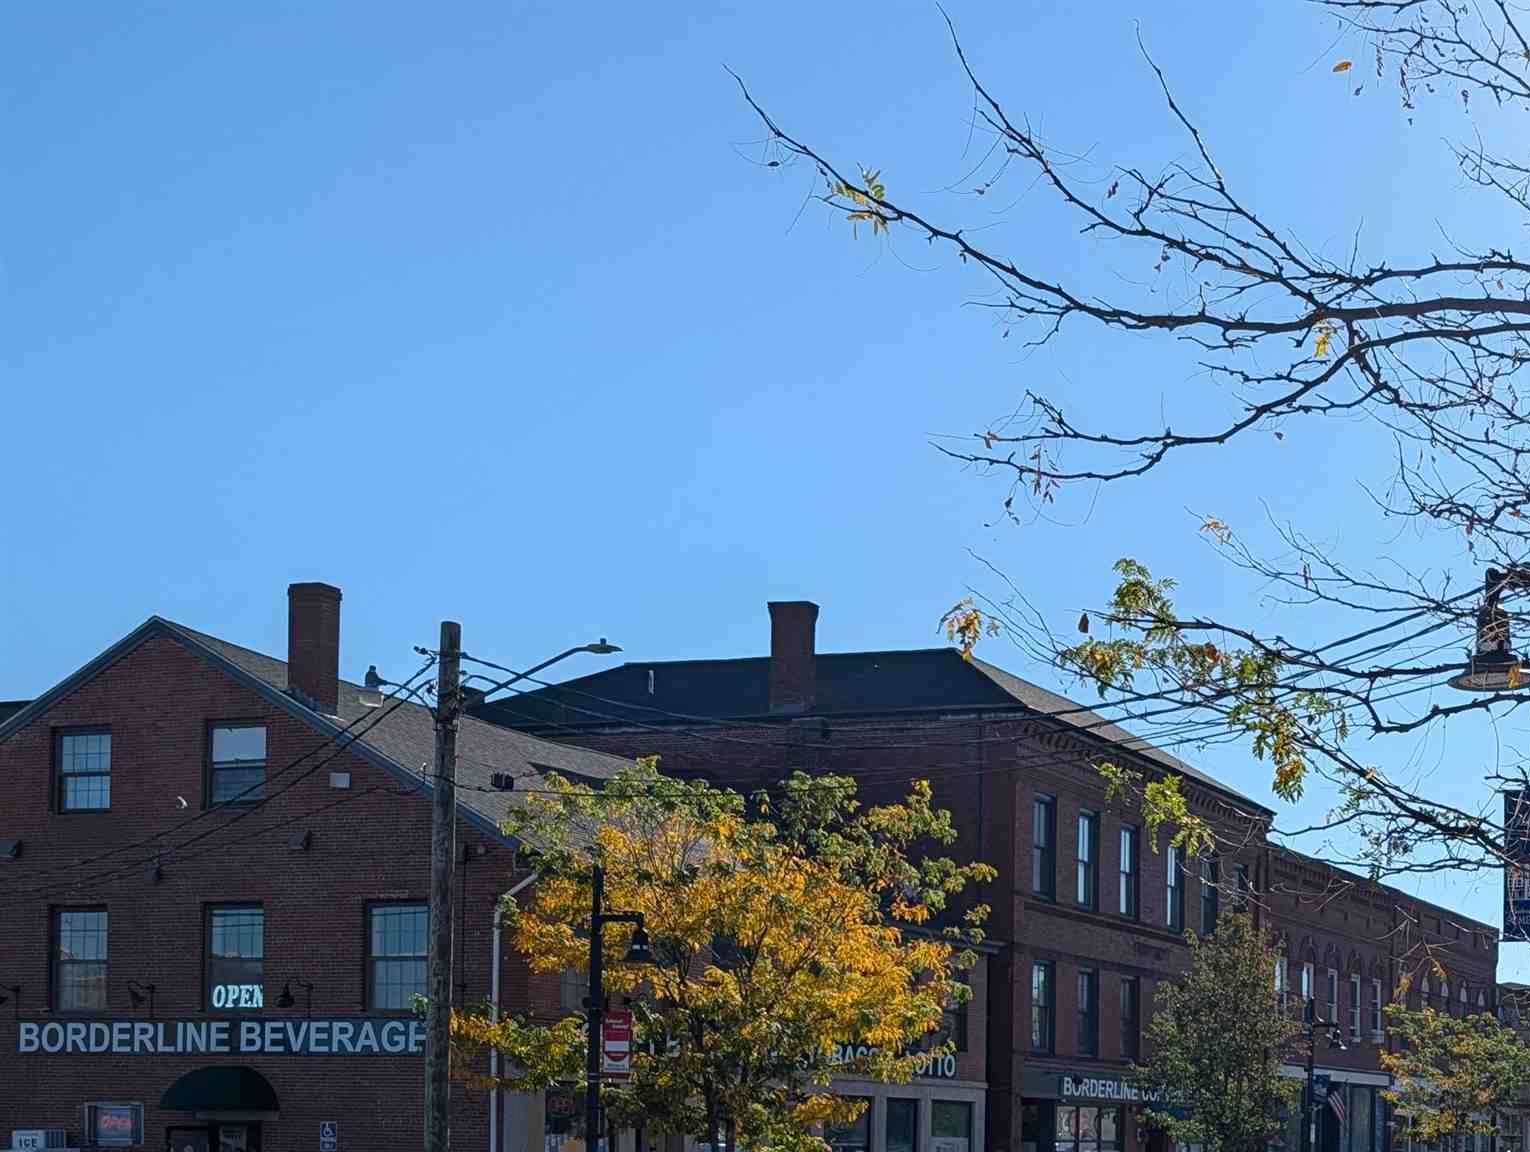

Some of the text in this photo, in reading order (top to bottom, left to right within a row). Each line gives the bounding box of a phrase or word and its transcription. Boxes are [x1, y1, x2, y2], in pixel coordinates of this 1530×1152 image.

[212, 984, 263, 1009] OPEN
[18, 1021, 230, 1053] BORDERLINE
[18, 1136, 38, 1148] ICE
